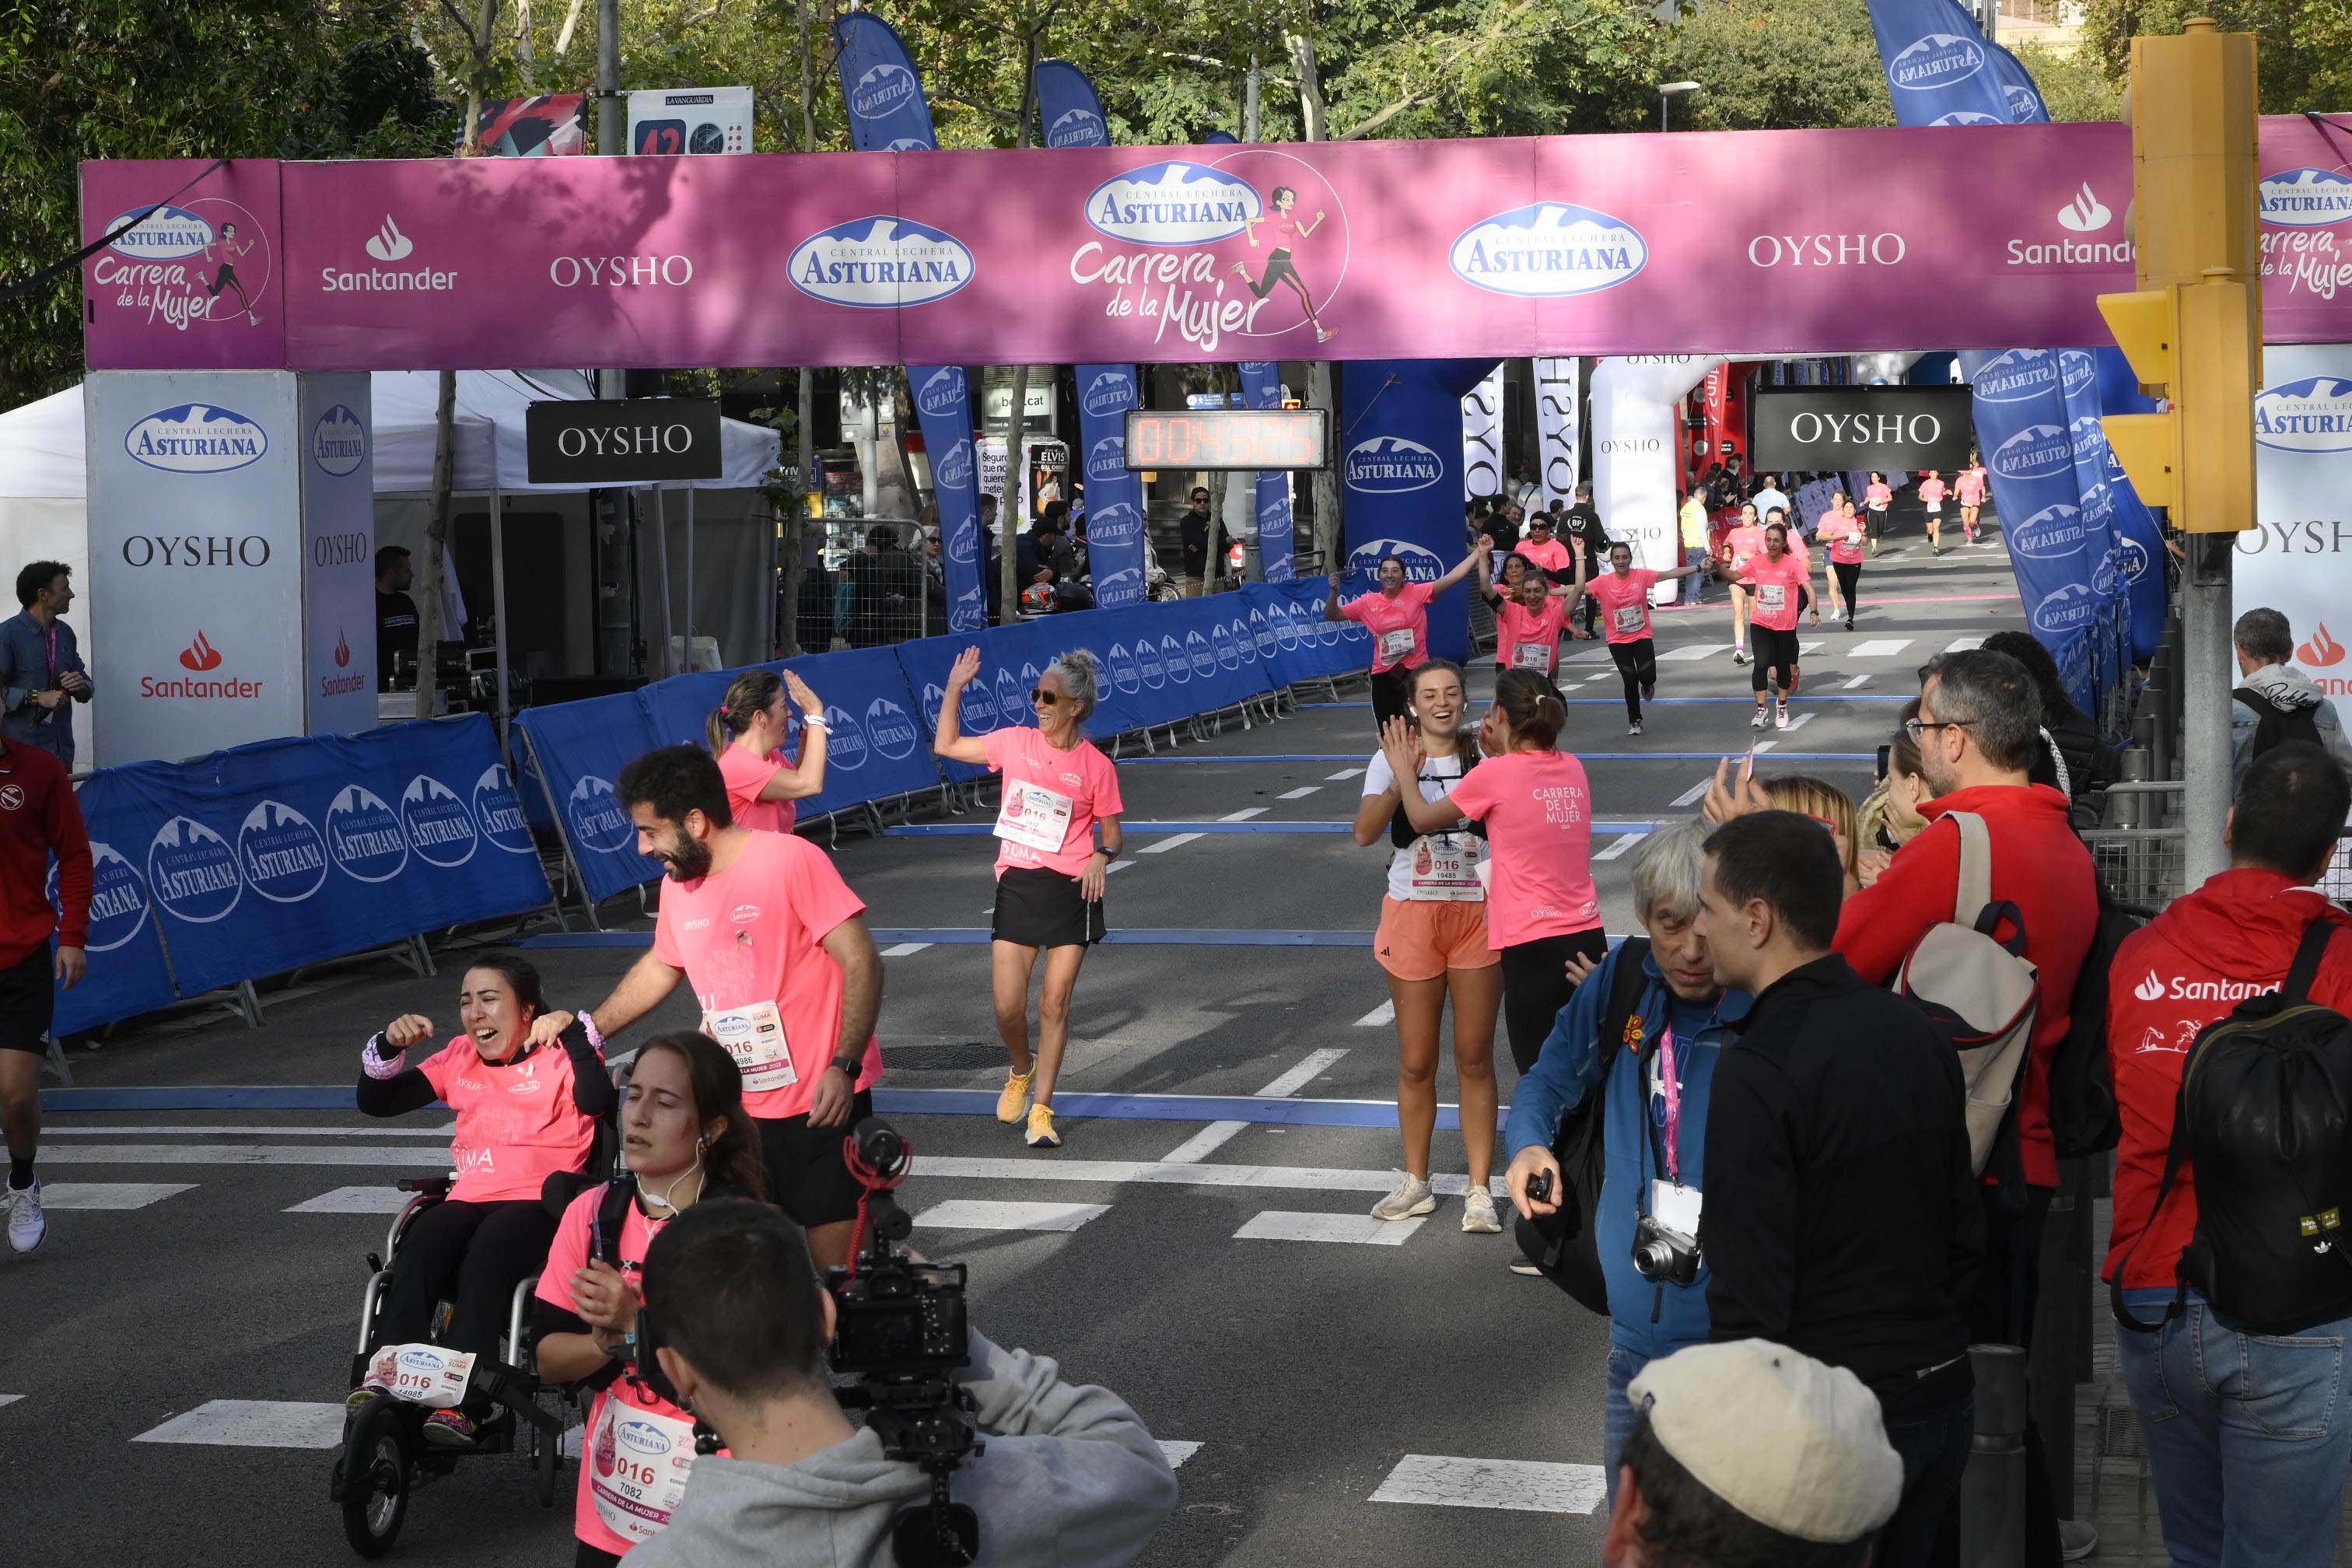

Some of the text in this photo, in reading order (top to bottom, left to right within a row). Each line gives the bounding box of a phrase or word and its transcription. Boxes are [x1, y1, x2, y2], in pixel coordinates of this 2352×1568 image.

[1125, 188, 1244, 201] CENTRAL LECHERA
[1097, 193, 1248, 225] ASTURIANA
[112, 224, 205, 246] ASTURIANA
[1495, 233, 1626, 247] CENTRAL LECHERA
[2260, 230, 2336, 254] arrera
[830, 246, 954, 258] CENTRAL LECHERA
[1070, 240, 1214, 285] Carrera
[1465, 238, 1633, 274] ASTURIANA
[1748, 233, 1906, 267] OYSHO
[2007, 239, 2137, 265] Santand
[94, 256, 186, 285] Carrera
[322, 267, 458, 292] Santander
[550, 255, 693, 286] OYSHO
[801, 250, 961, 285] ASTURIANA
[2278, 255, 2293, 276] la
[2289, 249, 2352, 300] Muje
[117, 282, 221, 331] de la Mujer
[1105, 281, 1270, 353] de la Mujer
[558, 424, 693, 457] OYSHO
[1790, 412, 1941, 445] OYSHO
[136, 429, 258, 457] ASTURIANA
[316, 432, 363, 460] ASTURIANA
[1601, 438, 1661, 454] OYSHO
[1041, 451, 1065, 461] ELVIS
[983, 465, 996, 475] que
[983, 474, 1006, 486] quiere
[1349, 460, 1436, 481] ASTURIANA
[122, 535, 271, 567] OYSHO
[315, 533, 367, 567] OYSHO
[141, 676, 263, 698] Santander
[322, 672, 366, 698] Santander
[1533, 786, 1584, 800] CARRERA
[1546, 799, 1578, 811] DE LA
[1024, 807, 1046, 821] 016
[1546, 811, 1581, 824] MUJER
[408, 812, 474, 847] ASTURIANA
[333, 825, 404, 862] ASTURIANA
[1002, 841, 1041, 863] SUMA
[246, 843, 324, 882] ASTURIANA
[1434, 860, 1460, 870] 016
[158, 860, 239, 902] ASTURIANA
[684, 918, 710, 931] OYSHO
[2170, 975, 2281, 1001] Santand
[717, 1023, 748, 1033] ASTURIANA
[753, 1013, 772, 1021] SUMA
[724, 1041, 753, 1055] 016
[735, 1057, 753, 1066] 4986
[758, 1073, 787, 1084] Santander
[455, 1145, 494, 1174] UMA
[403, 1356, 439, 1369] ASTURIANA
[399, 1374, 432, 1389] 016
[620, 1426, 666, 1452] ASTURIANA
[617, 1457, 656, 1486] 016
[597, 1485, 660, 1520] CARRERA DE LA MUJER
[620, 1481, 642, 1500] 7082
